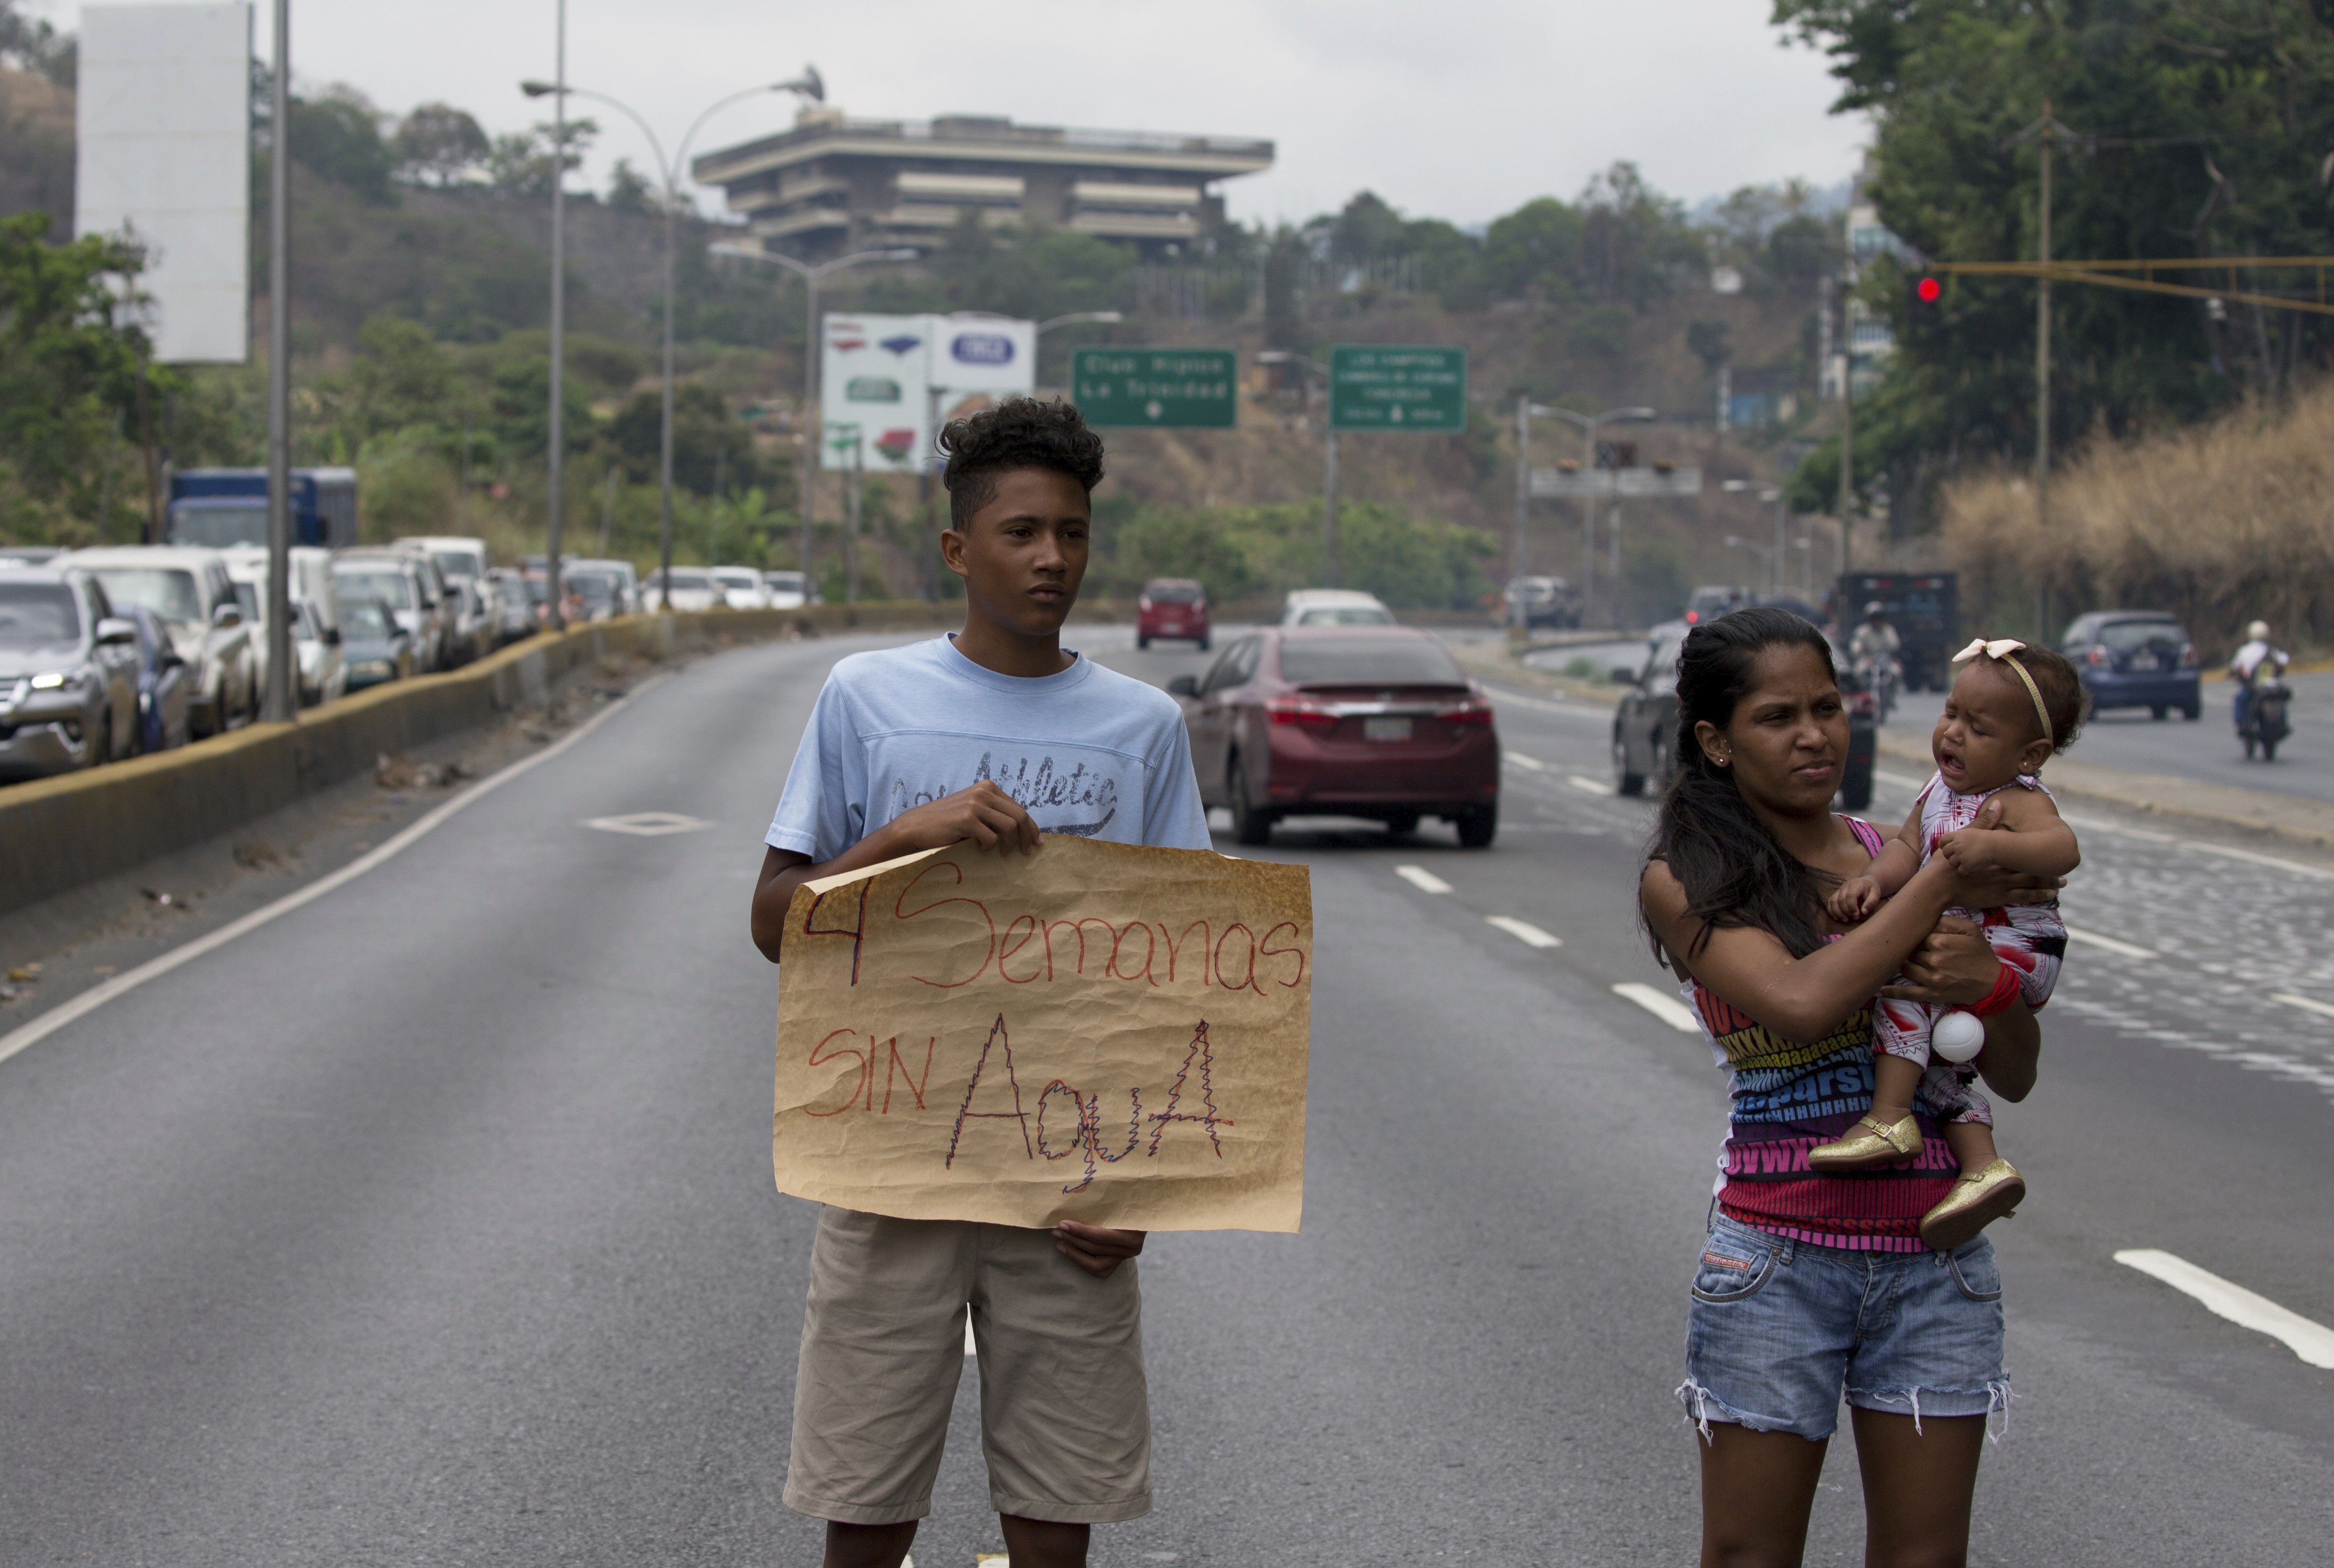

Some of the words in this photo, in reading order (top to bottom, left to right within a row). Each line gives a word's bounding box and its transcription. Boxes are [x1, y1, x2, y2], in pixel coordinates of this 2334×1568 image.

[803, 875, 873, 987] 4
[895, 862, 1305, 996] Semanas
[804, 1029, 935, 1117] SIN
